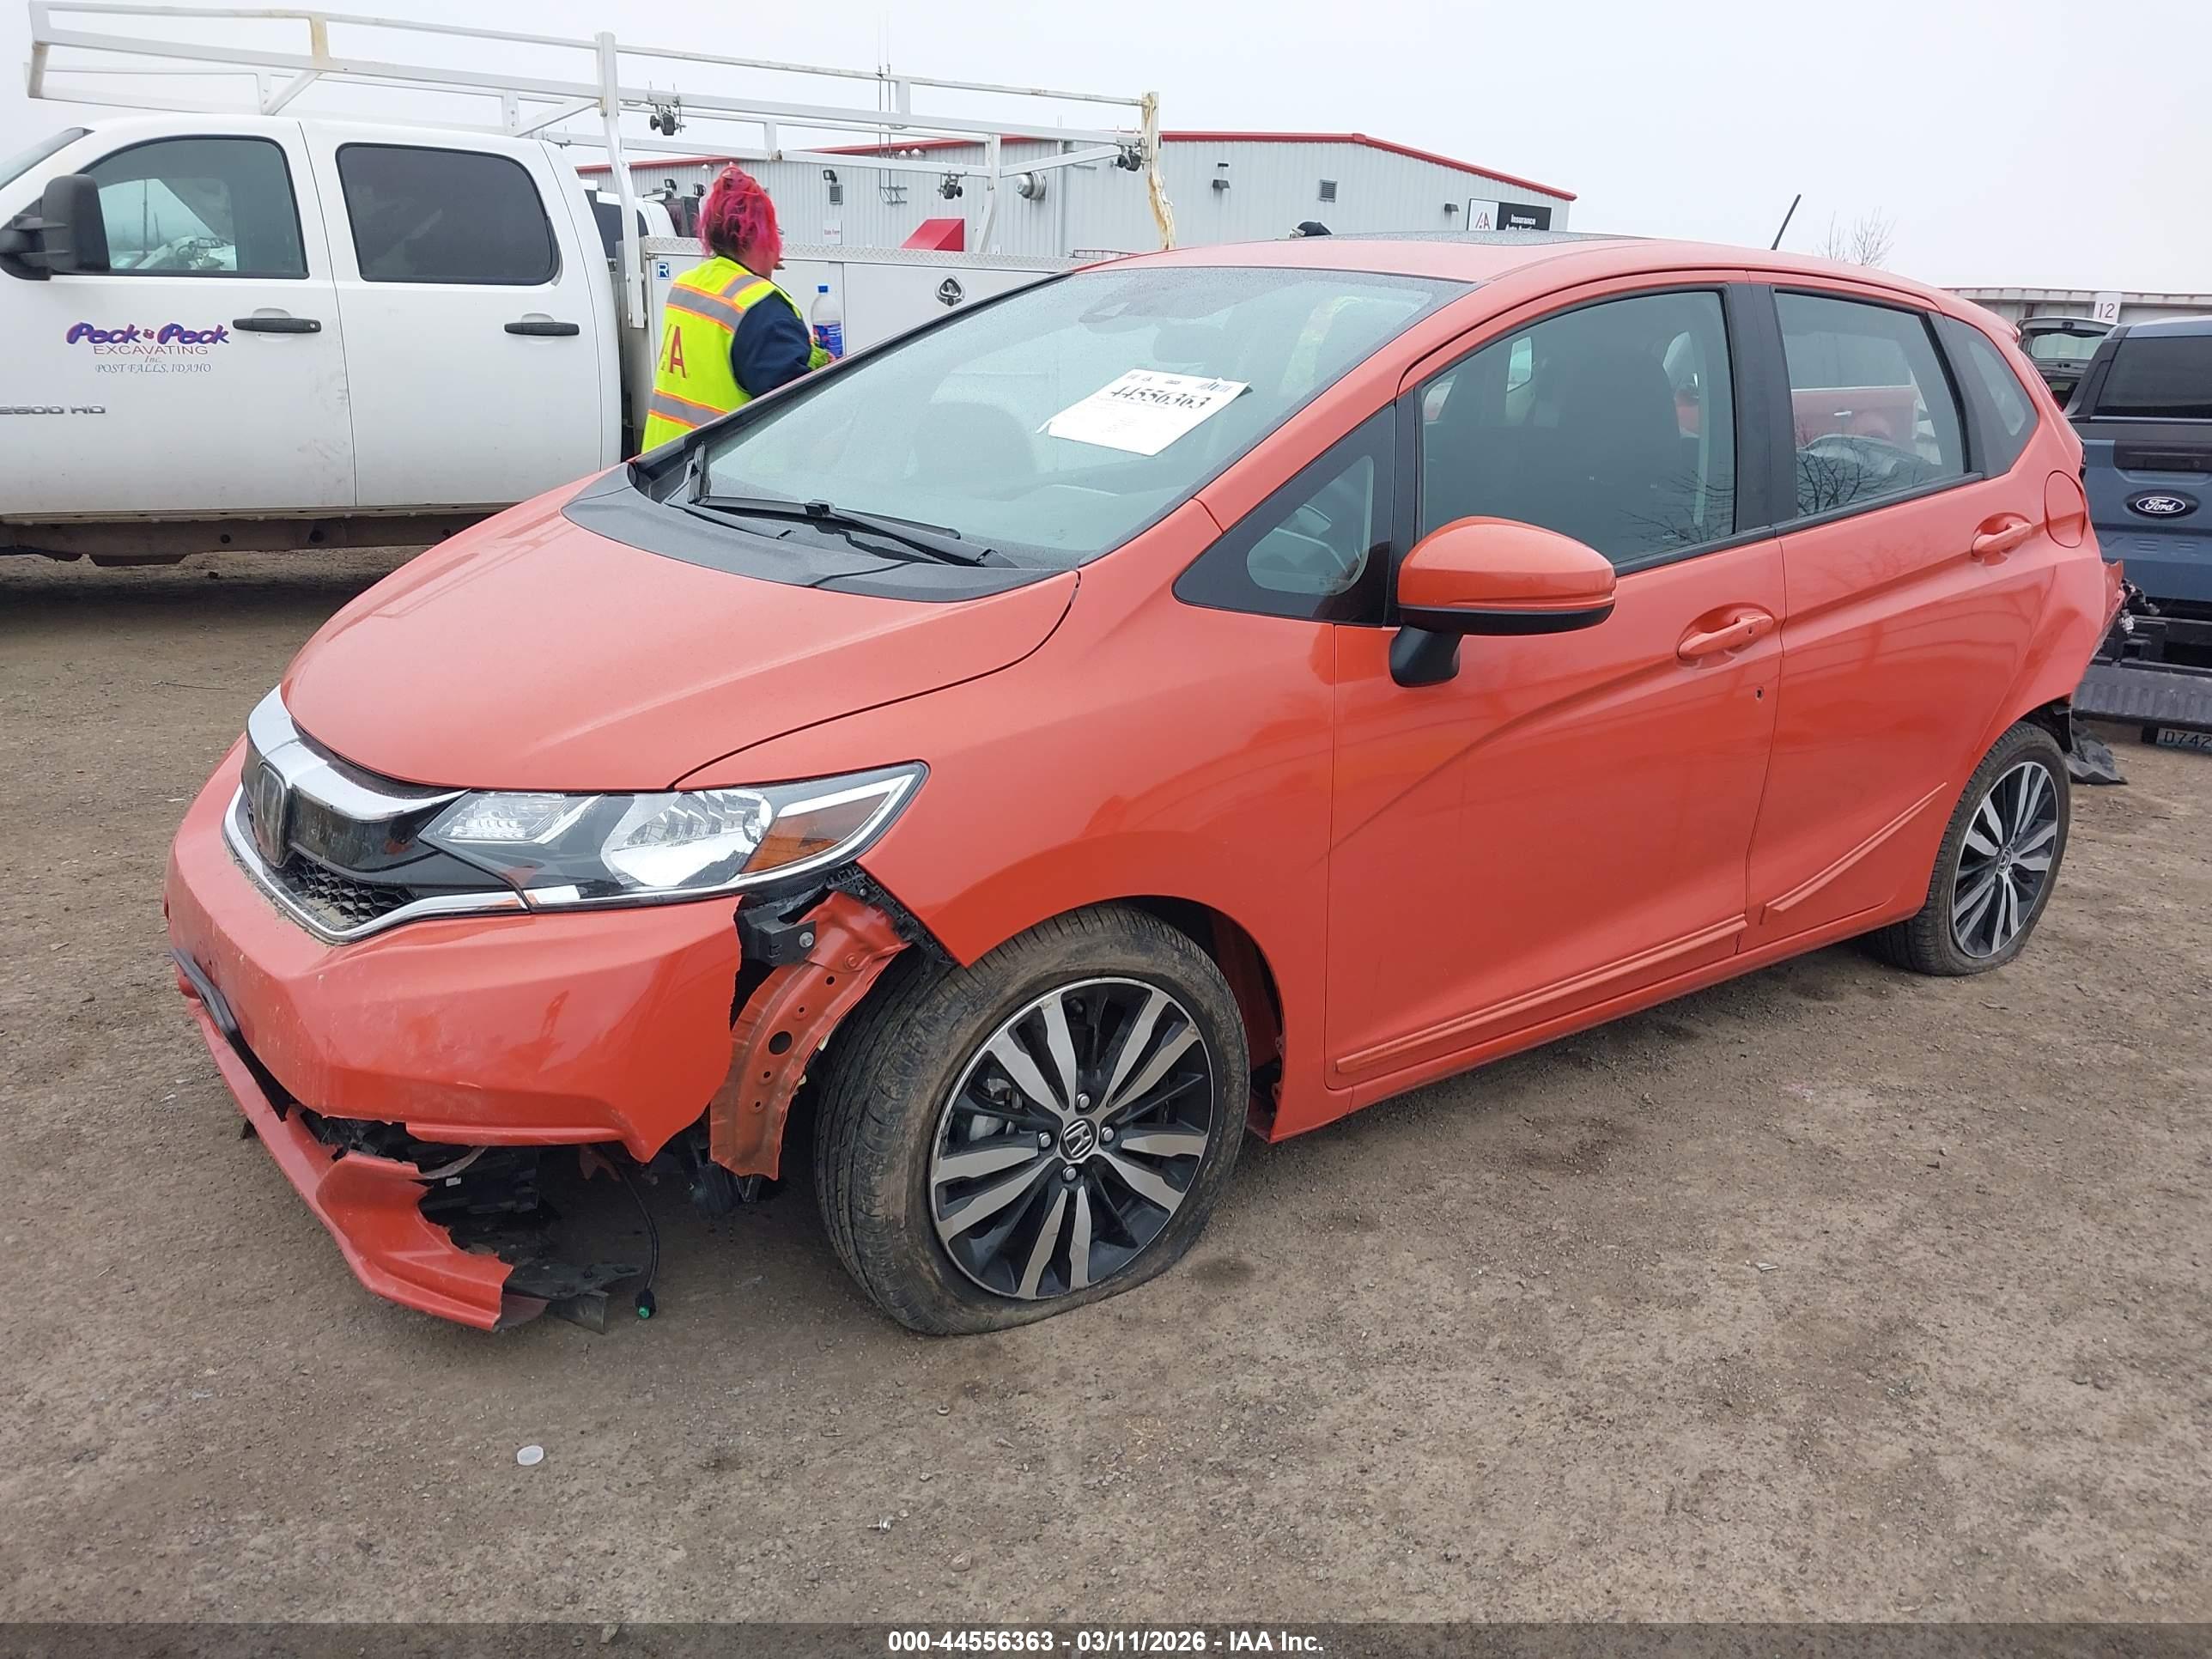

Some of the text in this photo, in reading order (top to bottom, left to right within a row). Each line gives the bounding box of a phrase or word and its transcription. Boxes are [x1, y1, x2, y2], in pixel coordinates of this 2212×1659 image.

[1511, 214, 1536, 225] Insurance
[658, 263, 669, 277] R
[2099, 303, 2115, 318] 12
[66, 322, 141, 344] Peck
[157, 323, 230, 344] Peck
[94, 345, 208, 355] EXCAVATING
[95, 363, 127, 373] POST
[171, 364, 212, 373] IDAHO
[2145, 498, 2176, 511] Ford
